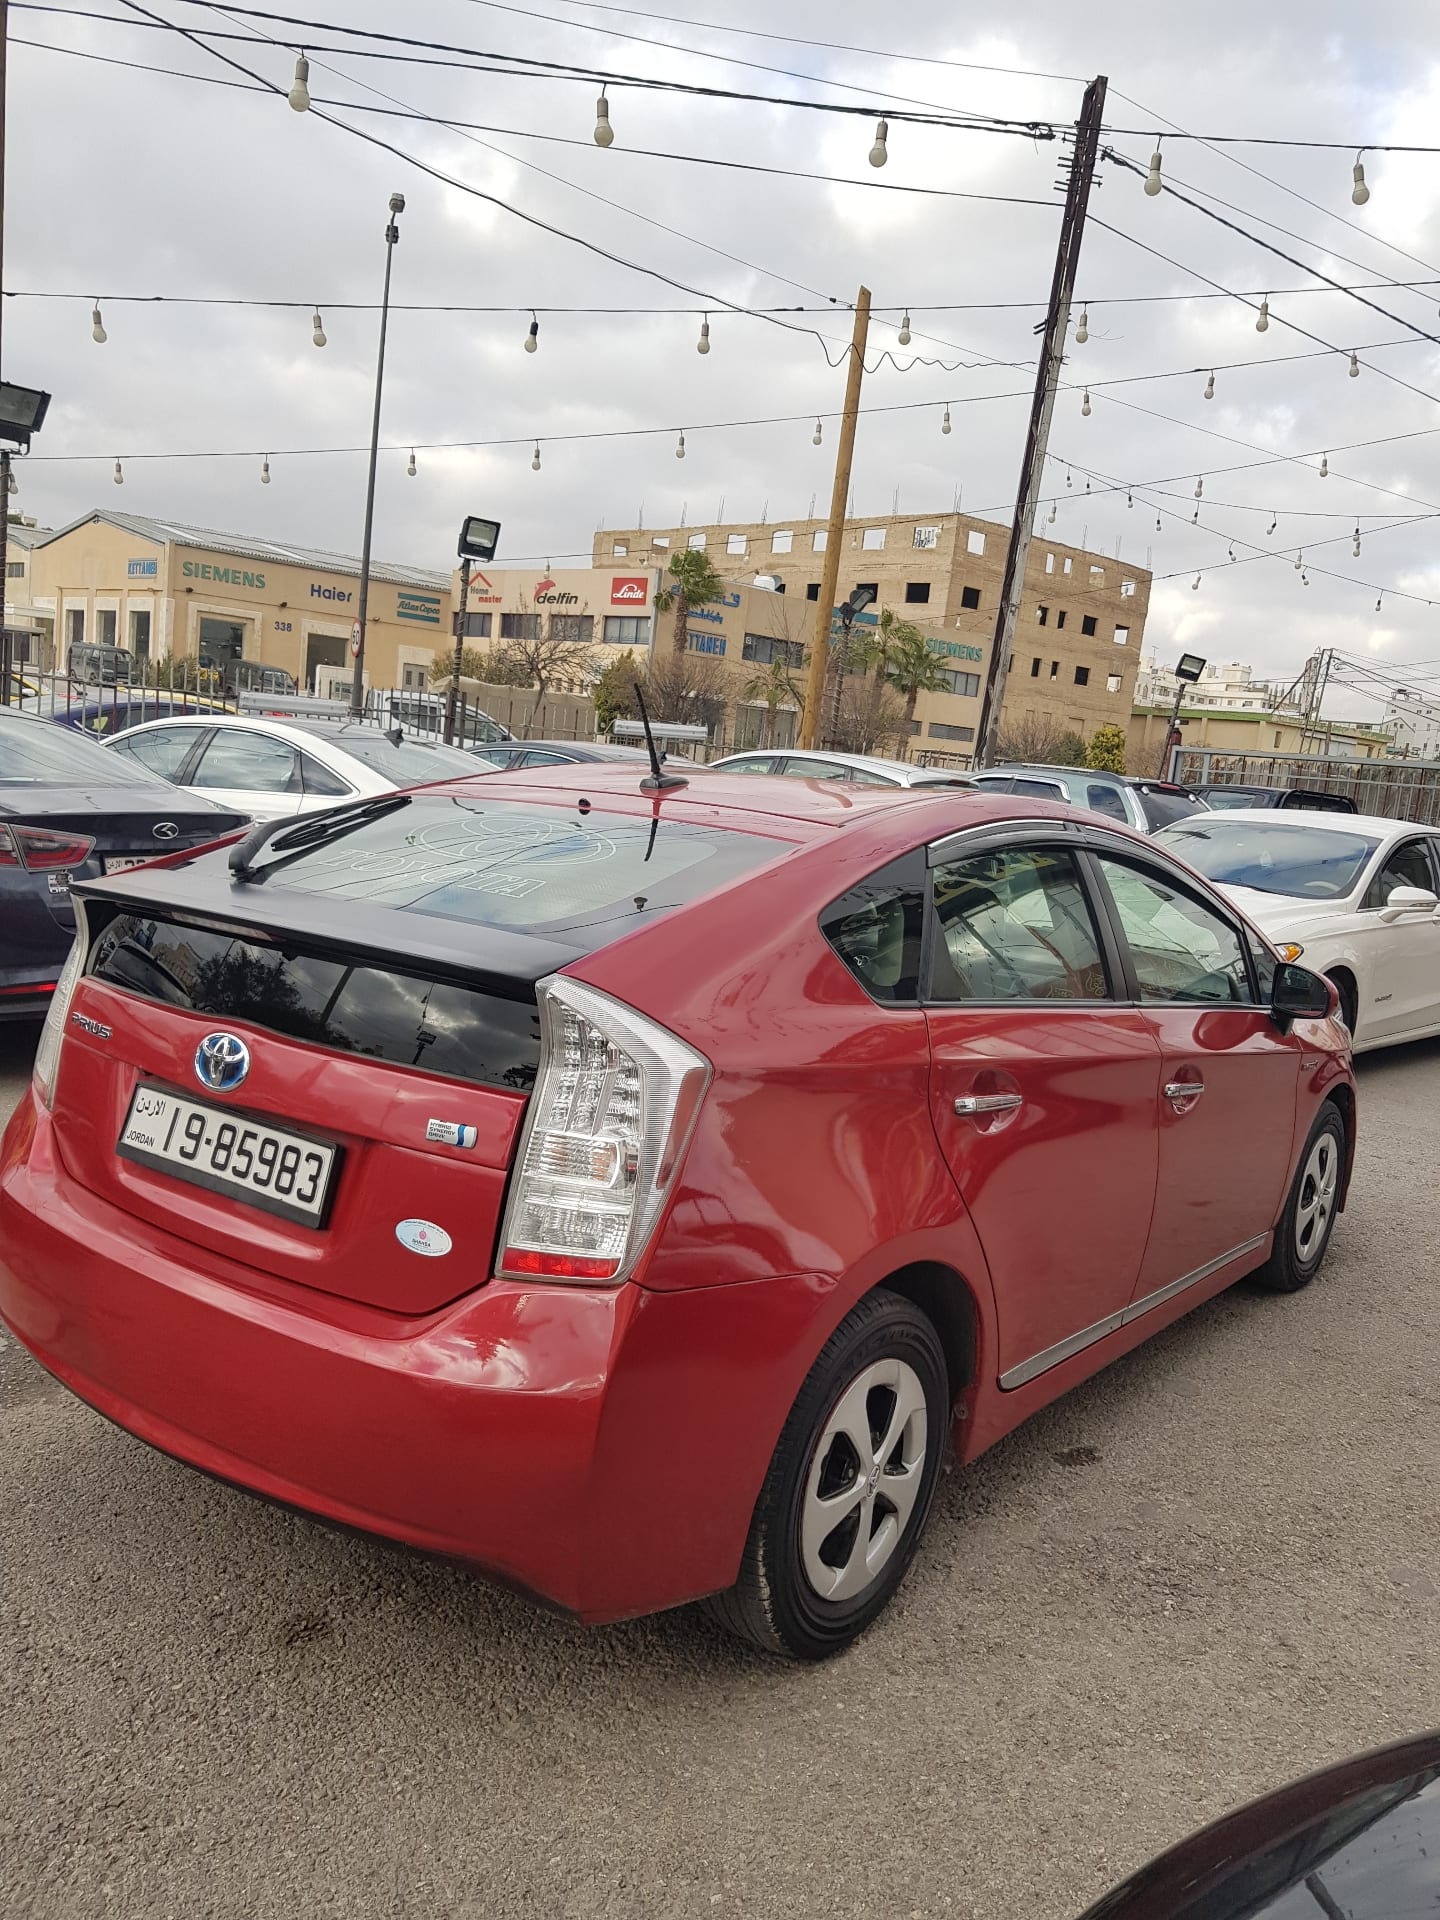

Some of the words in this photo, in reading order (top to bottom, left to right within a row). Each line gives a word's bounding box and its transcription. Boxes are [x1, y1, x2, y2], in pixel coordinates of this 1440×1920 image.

[182, 561, 266, 589] SIEMENS
[310, 583, 353, 603] Haier
[536, 592, 579, 605] delfin
[613, 583, 644, 599] Linde
[274, 621, 292, 632] 338
[925, 637, 983, 662] SIEMENS
[72, 1011, 113, 1040] PRIUS
[126, 1130, 155, 1148] JORDAN
[429, 1126, 456, 1136] SYNERGY
